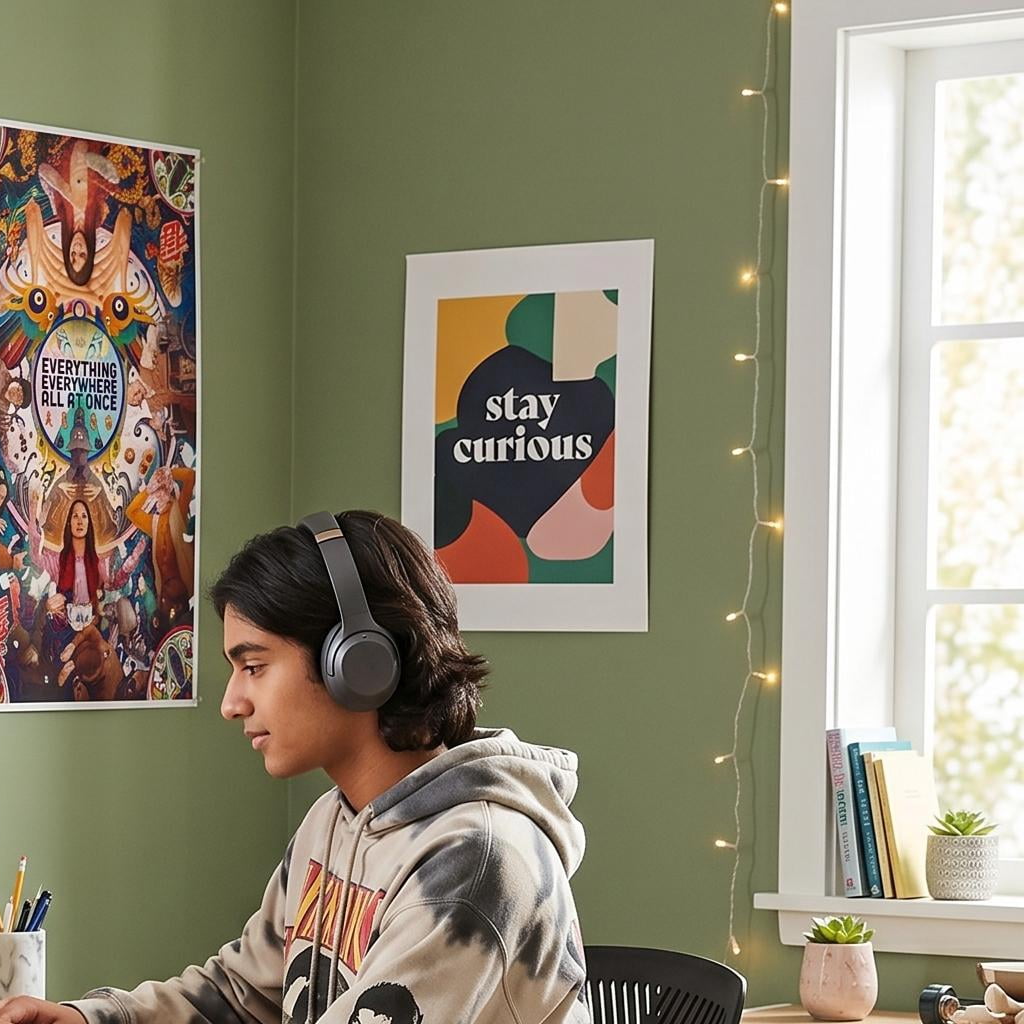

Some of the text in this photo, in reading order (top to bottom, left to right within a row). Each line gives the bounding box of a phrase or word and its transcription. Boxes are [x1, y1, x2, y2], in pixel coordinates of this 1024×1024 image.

[41, 357, 117, 379] EVERYTHING
[41, 375, 117, 394] EVERYWHERE
[86, 393, 117, 411] ONCE
[485, 387, 561, 430] stay
[453, 424, 593, 463] curious
